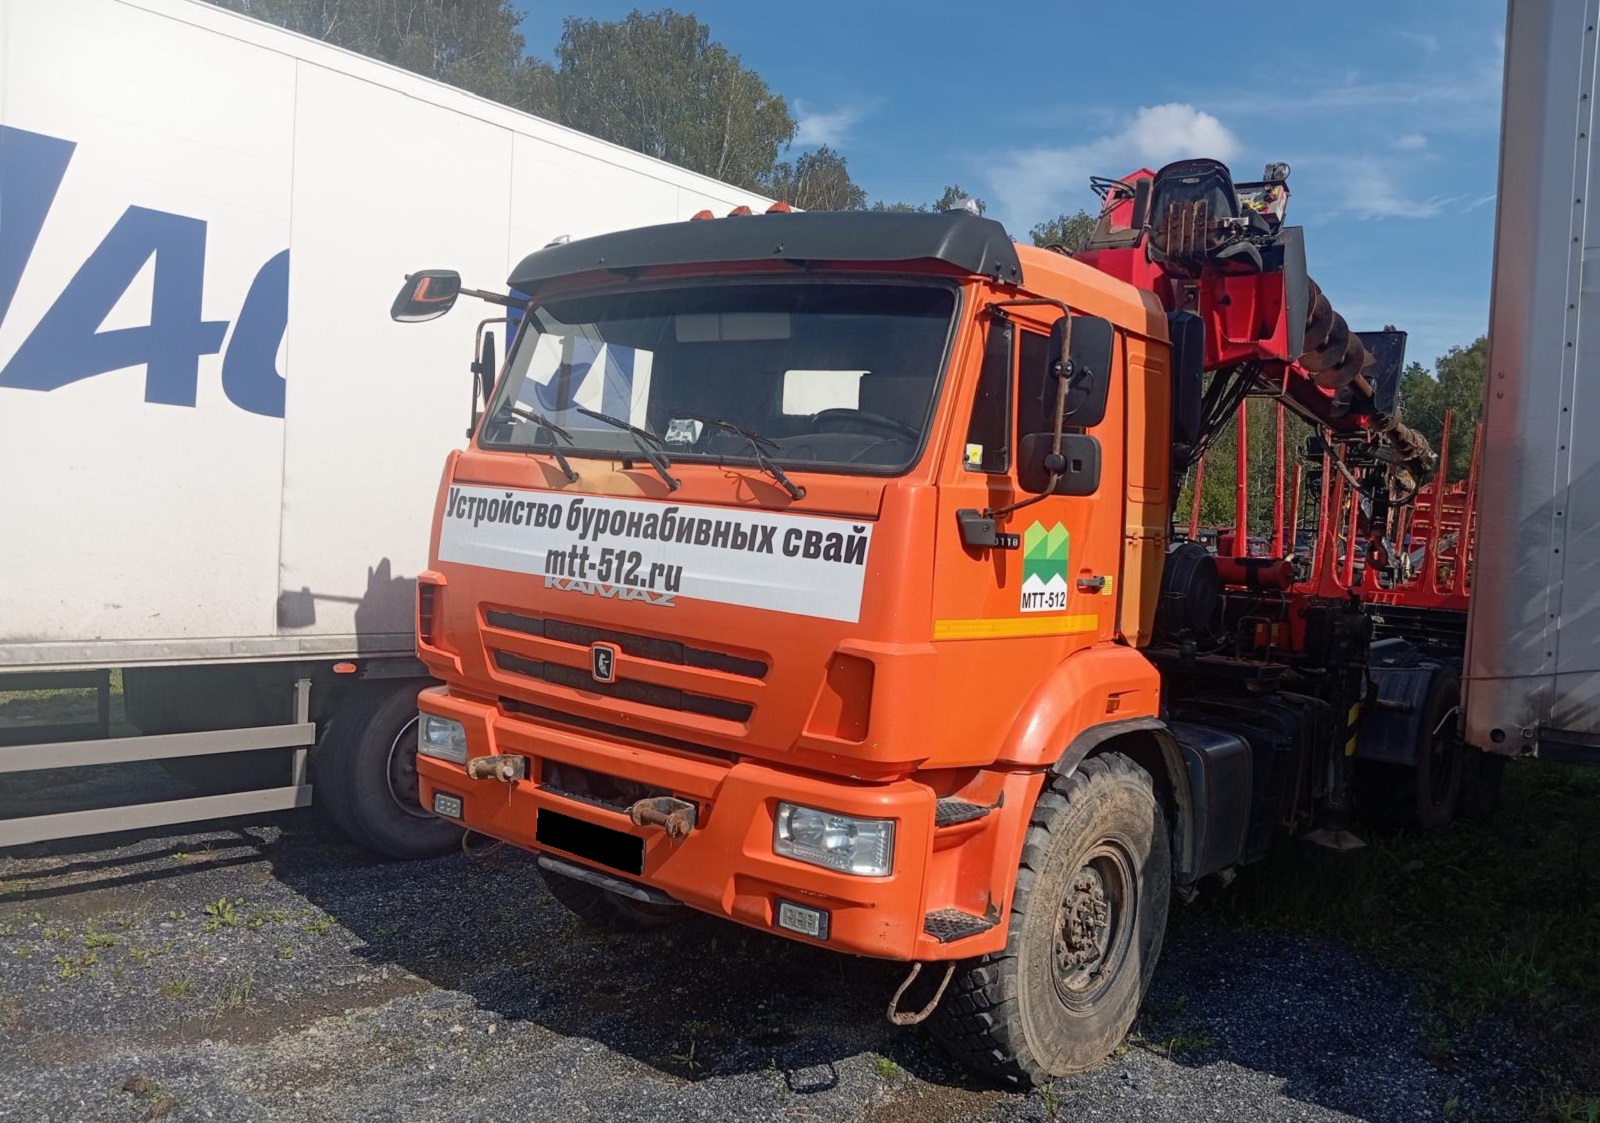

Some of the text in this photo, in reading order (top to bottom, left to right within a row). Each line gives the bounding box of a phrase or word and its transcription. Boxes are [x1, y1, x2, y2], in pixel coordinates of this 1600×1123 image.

[447, 486, 868, 566] Устройство буронабивных свай
[544, 544, 683, 593] mtt-512.ru
